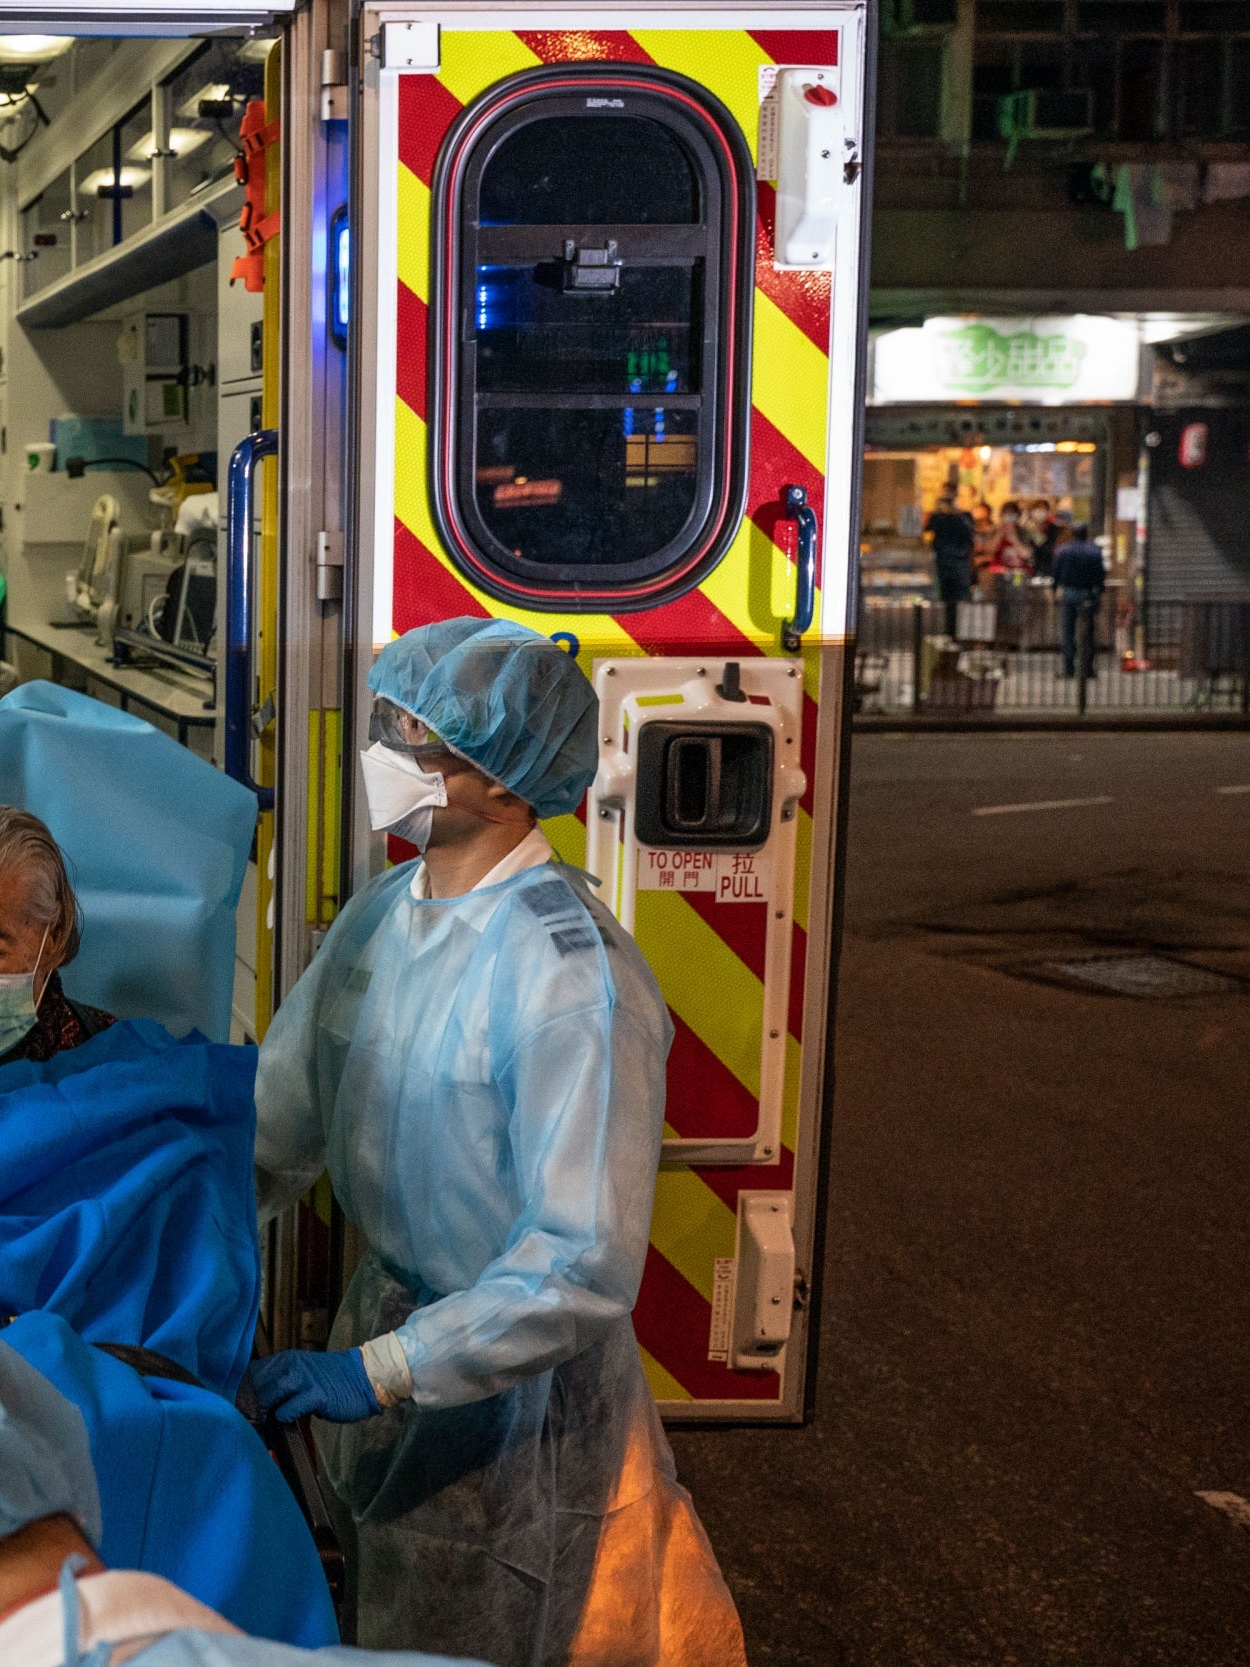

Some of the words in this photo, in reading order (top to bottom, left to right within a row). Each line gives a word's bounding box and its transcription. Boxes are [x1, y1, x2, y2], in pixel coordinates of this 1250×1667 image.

[648, 851, 668, 869] TO
[672, 851, 713, 870] OPEN
[732, 852, 755, 875] 拉
[658, 871, 699, 888] 開門
[720, 876, 764, 898] PULL
